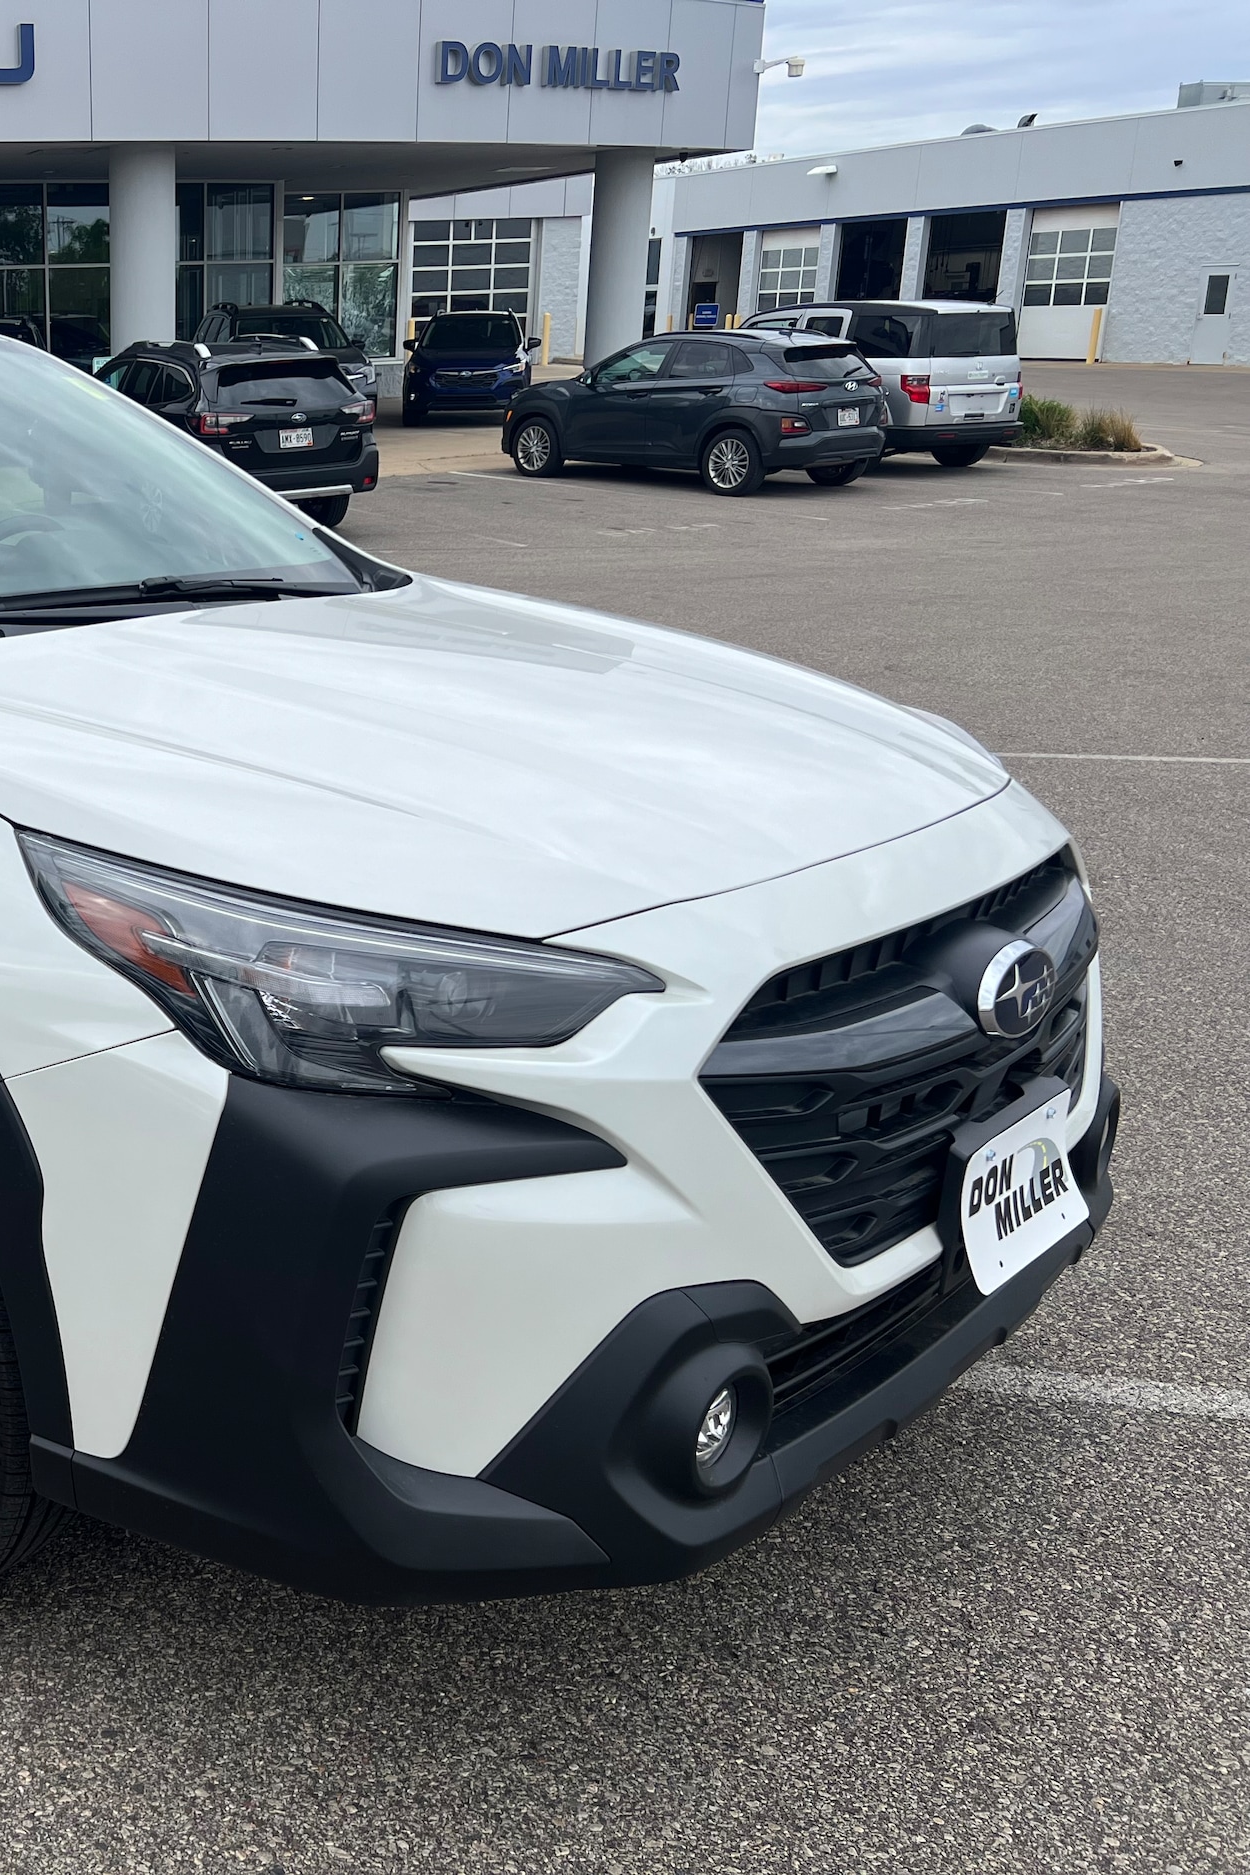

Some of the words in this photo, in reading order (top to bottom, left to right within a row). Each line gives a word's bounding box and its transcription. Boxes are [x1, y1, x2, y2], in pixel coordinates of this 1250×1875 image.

[435, 40, 533, 86] DON
[541, 45, 680, 92] MILLER
[969, 1154, 1014, 1218] DON
[994, 1158, 1069, 1241] MILLER
